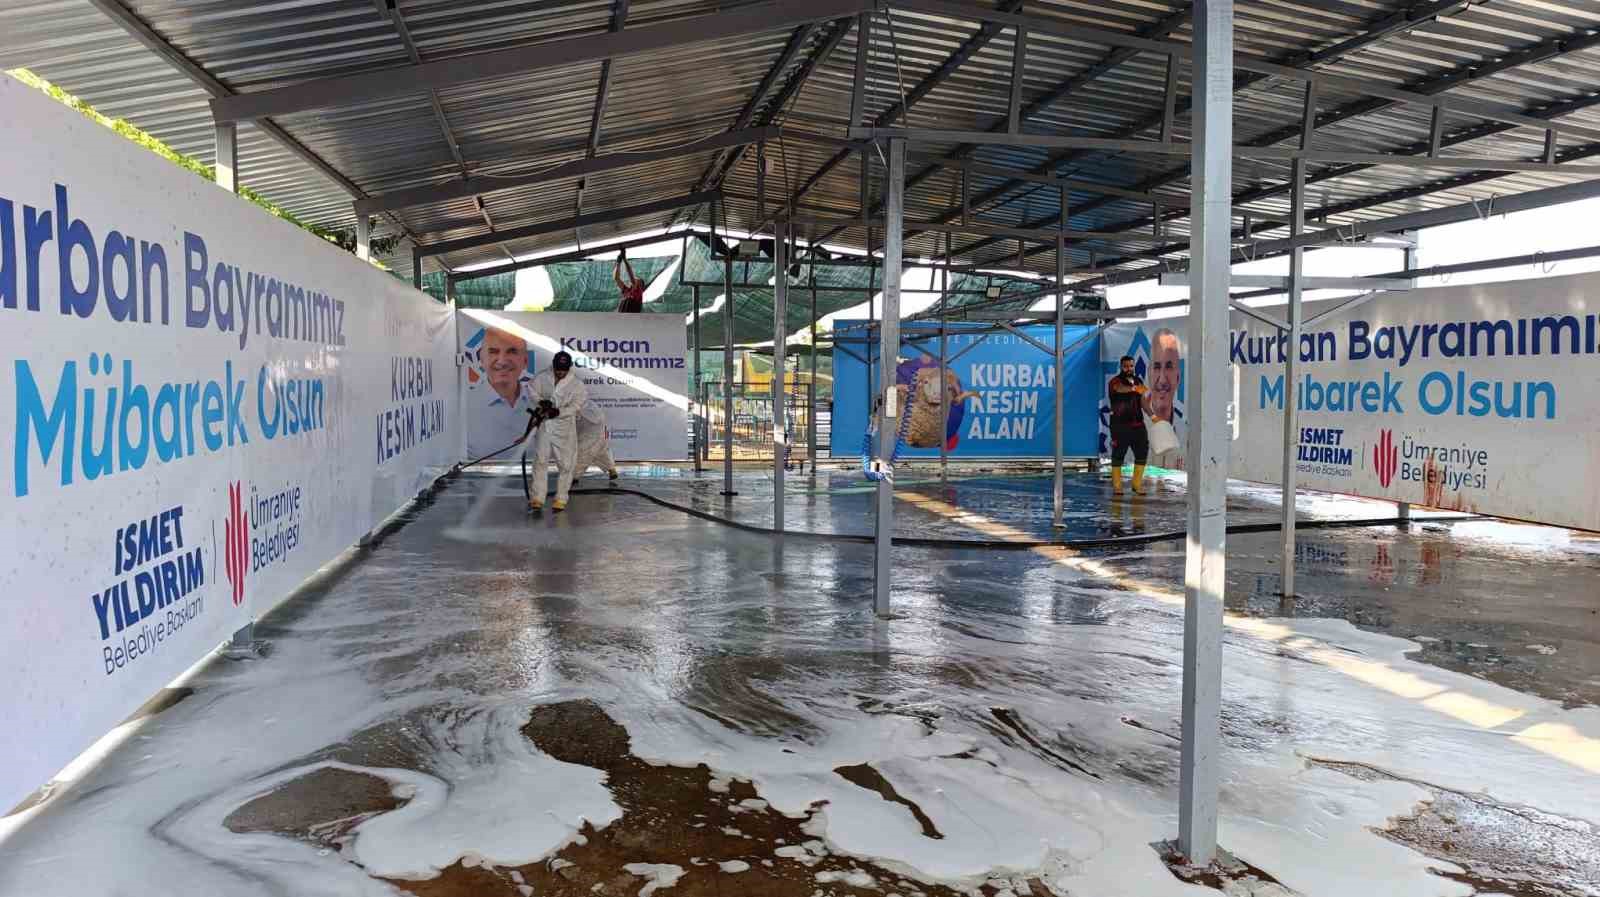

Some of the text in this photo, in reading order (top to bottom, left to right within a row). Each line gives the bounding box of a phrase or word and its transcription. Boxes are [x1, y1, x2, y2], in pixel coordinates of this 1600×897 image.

[184, 231, 346, 350] Bayramımız
[560, 337, 650, 353] Kurban
[1348, 314, 1600, 367] Bayramımı
[391, 357, 433, 402] KURBAN
[573, 356, 685, 371] ayramımız
[1418, 370, 1556, 420] Olsun
[14, 352, 325, 497] Mübarek Olsun
[967, 416, 1035, 440] ALANI
[1300, 427, 1344, 446] İSMET
[1297, 445, 1353, 466] ILDIRIM
[1402, 434, 1488, 469] Ümraniye
[1401, 462, 1488, 492] Belediyesi
[250, 485, 301, 530] Ümraniye
[114, 505, 184, 576] İSMET
[252, 520, 300, 573] Belediyesi
[92, 546, 204, 641] YILDIRIM
[103, 621, 165, 675] Belediye
